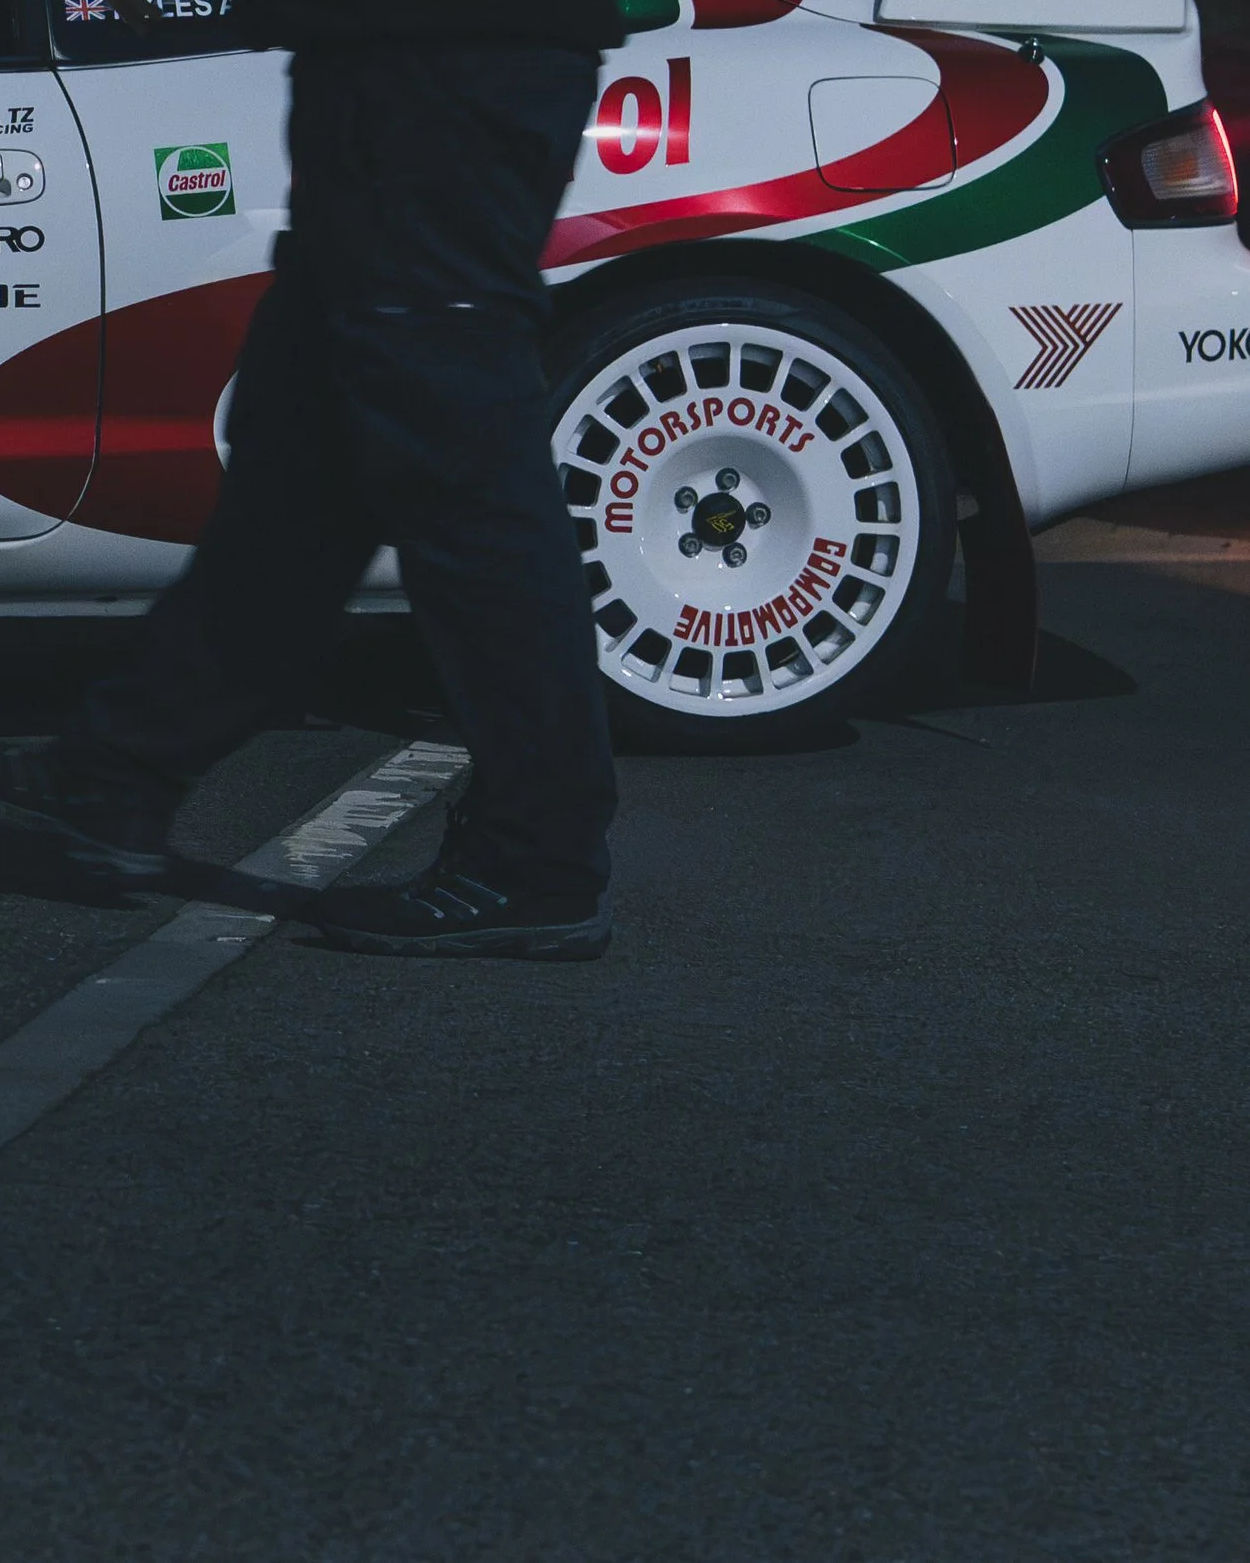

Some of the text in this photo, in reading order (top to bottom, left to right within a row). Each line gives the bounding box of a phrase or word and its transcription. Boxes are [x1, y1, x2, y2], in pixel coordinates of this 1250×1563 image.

[168, 169, 226, 192] Castrol
[1178, 327, 1250, 363] YOK
[604, 397, 815, 534] MOTORSPORTS
[673, 537, 848, 646] COMPOMOTIVE
